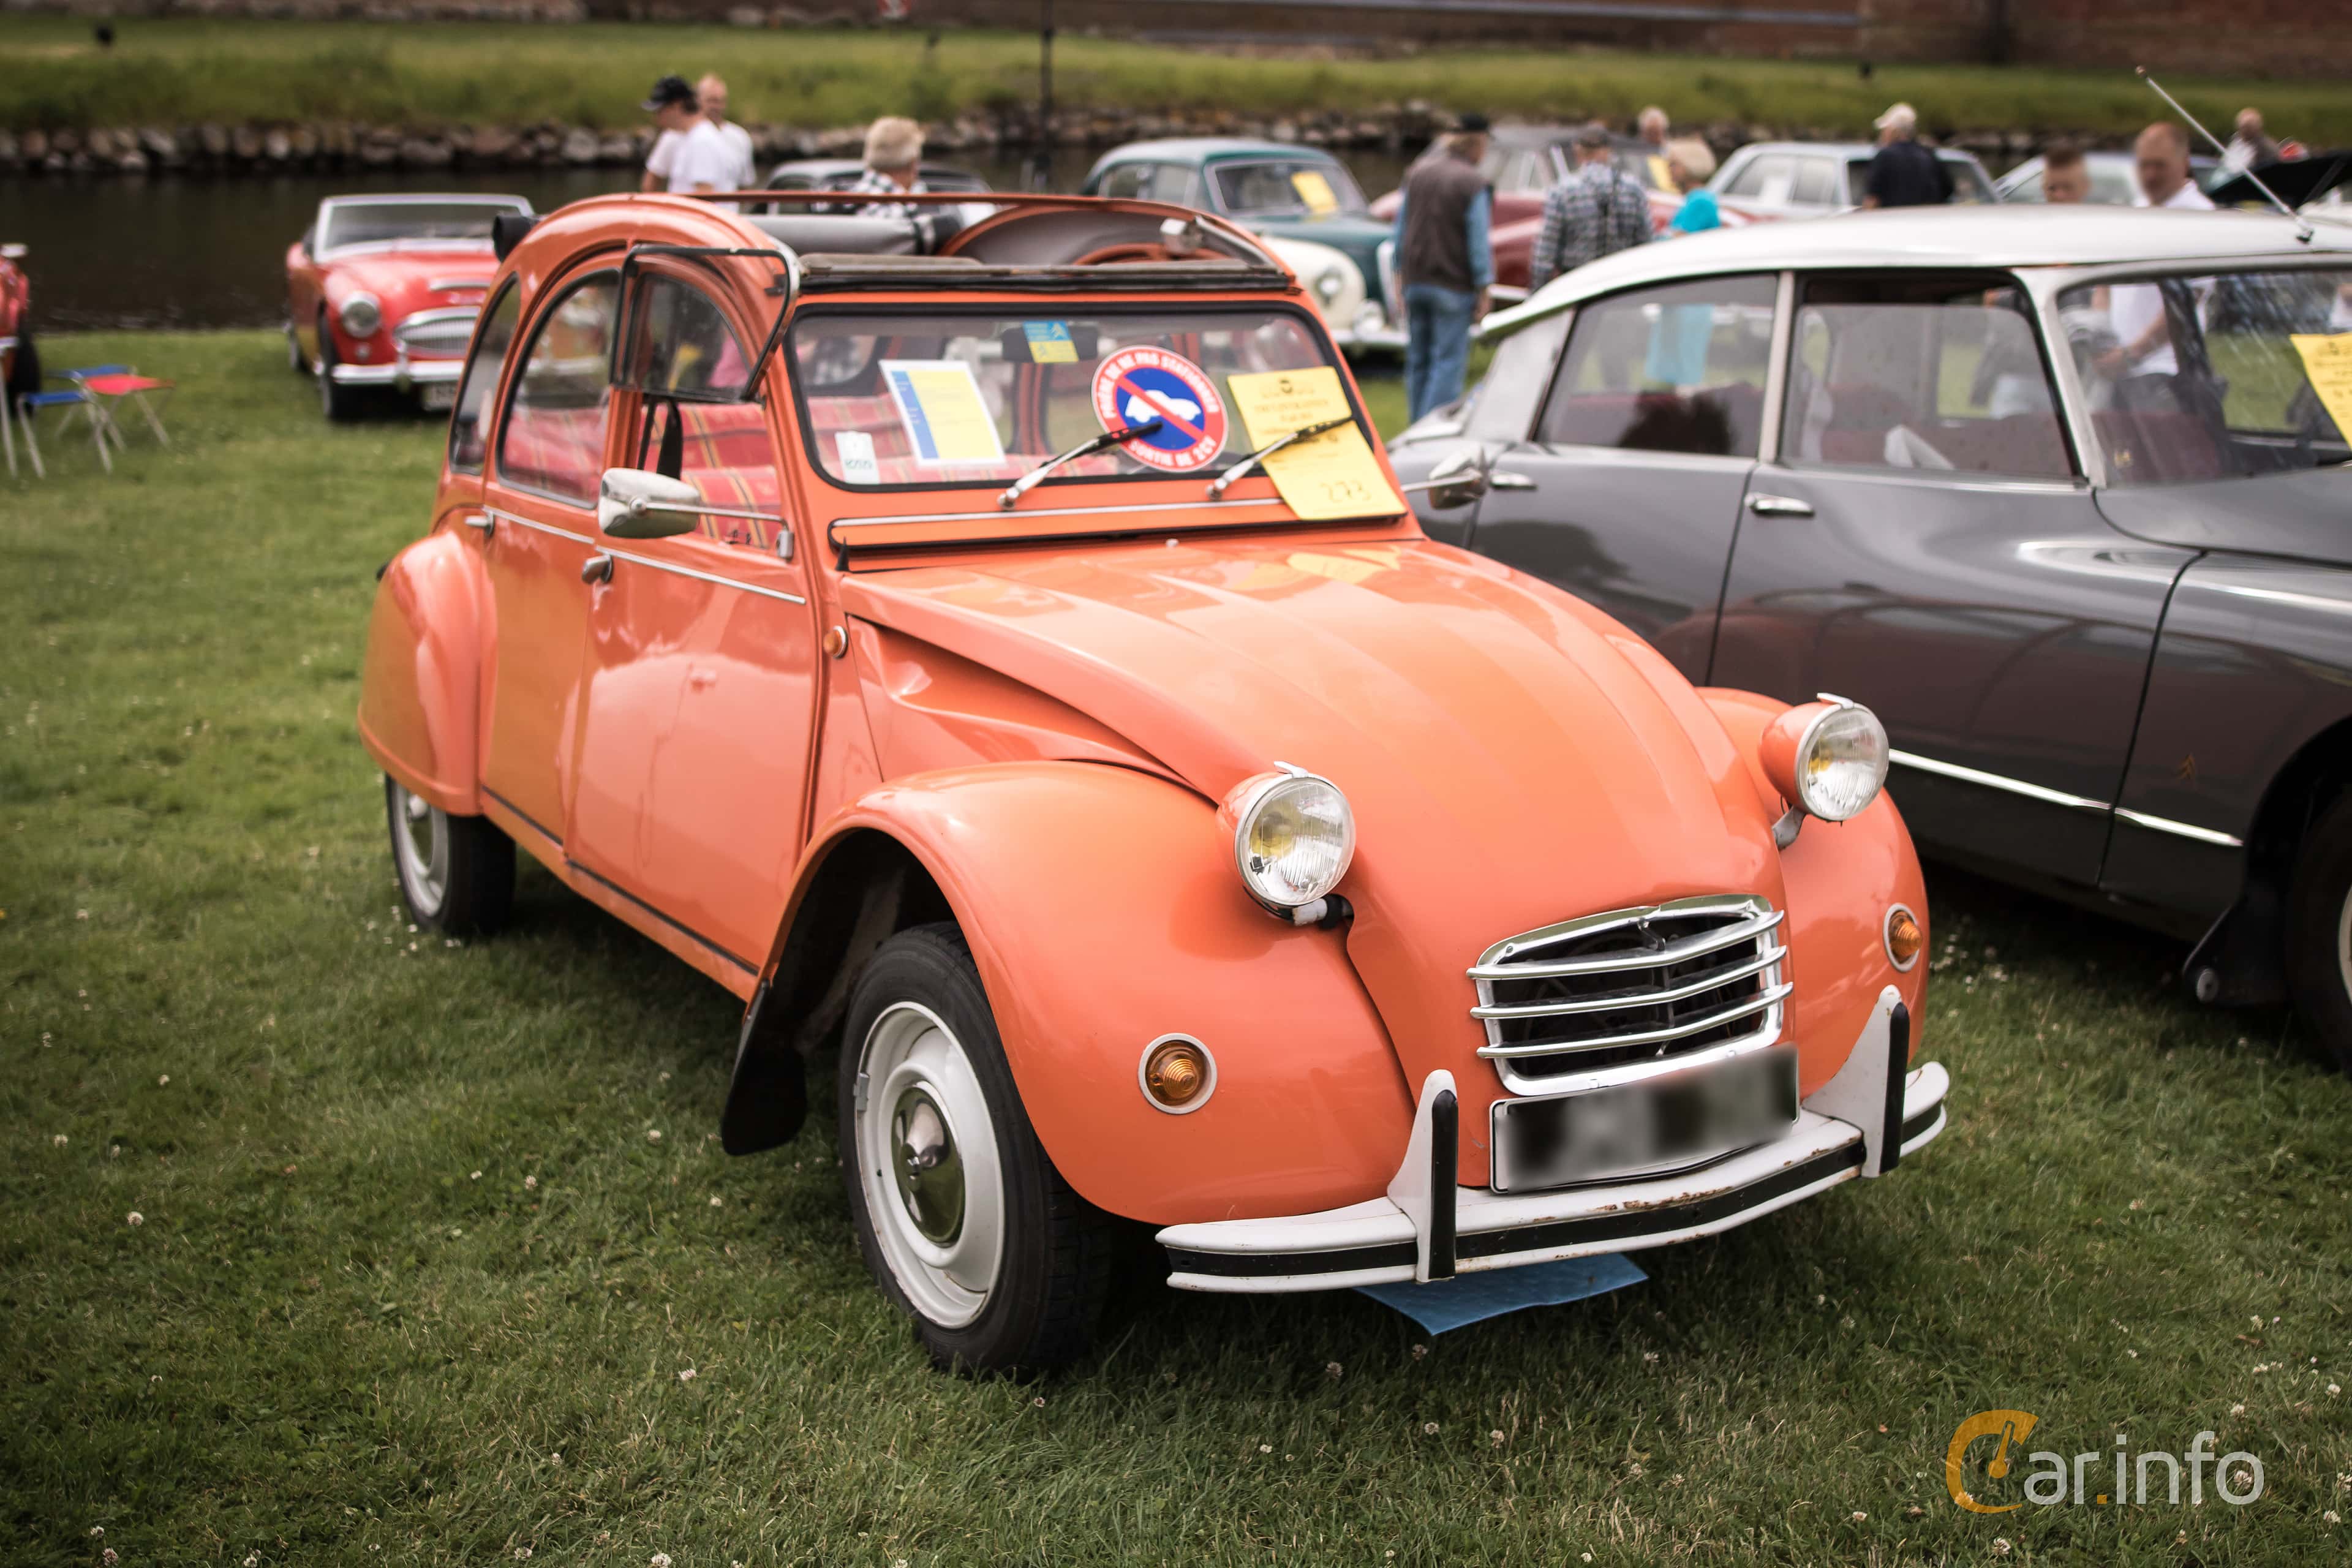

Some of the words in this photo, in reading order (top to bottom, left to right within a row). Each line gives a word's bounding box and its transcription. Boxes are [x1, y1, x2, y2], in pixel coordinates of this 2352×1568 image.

[1104, 363, 1122, 379] DE
[1117, 354, 1136, 369] NE
[1134, 352, 1160, 367] PAS
[1160, 354, 1220, 413] STATIONNER
[1175, 453, 1194, 467] DE
[1192, 435, 1216, 461] 2CV
